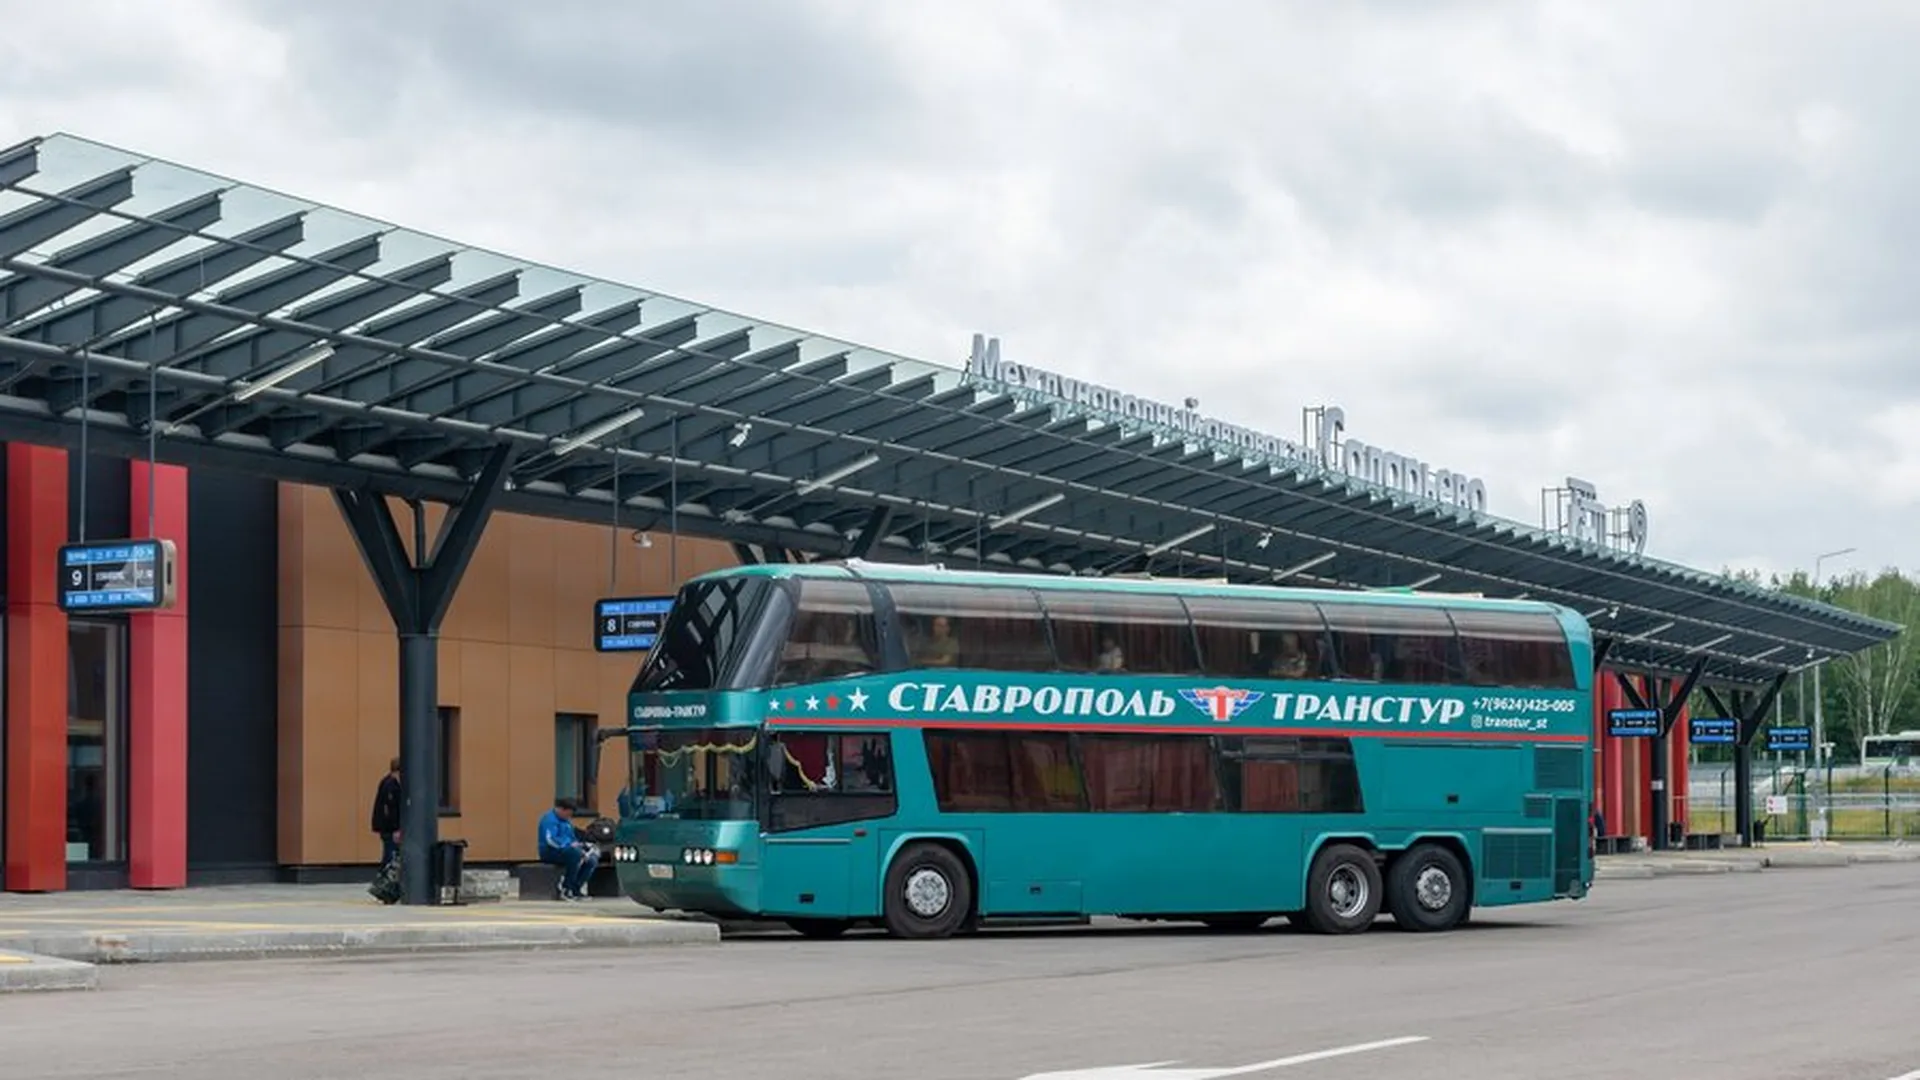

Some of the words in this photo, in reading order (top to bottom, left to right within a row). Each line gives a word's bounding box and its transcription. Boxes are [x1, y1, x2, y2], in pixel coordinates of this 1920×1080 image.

[73, 570, 83, 586] 9
[608, 619, 616, 632] 8
[888, 682, 1176, 717] СТАВРОПОЛЬ
[1272, 692, 1466, 725] ТРАНСТУР
[1472, 697, 1575, 713] +7(9624)425-005
[1484, 715, 1547, 731] transtur_st
